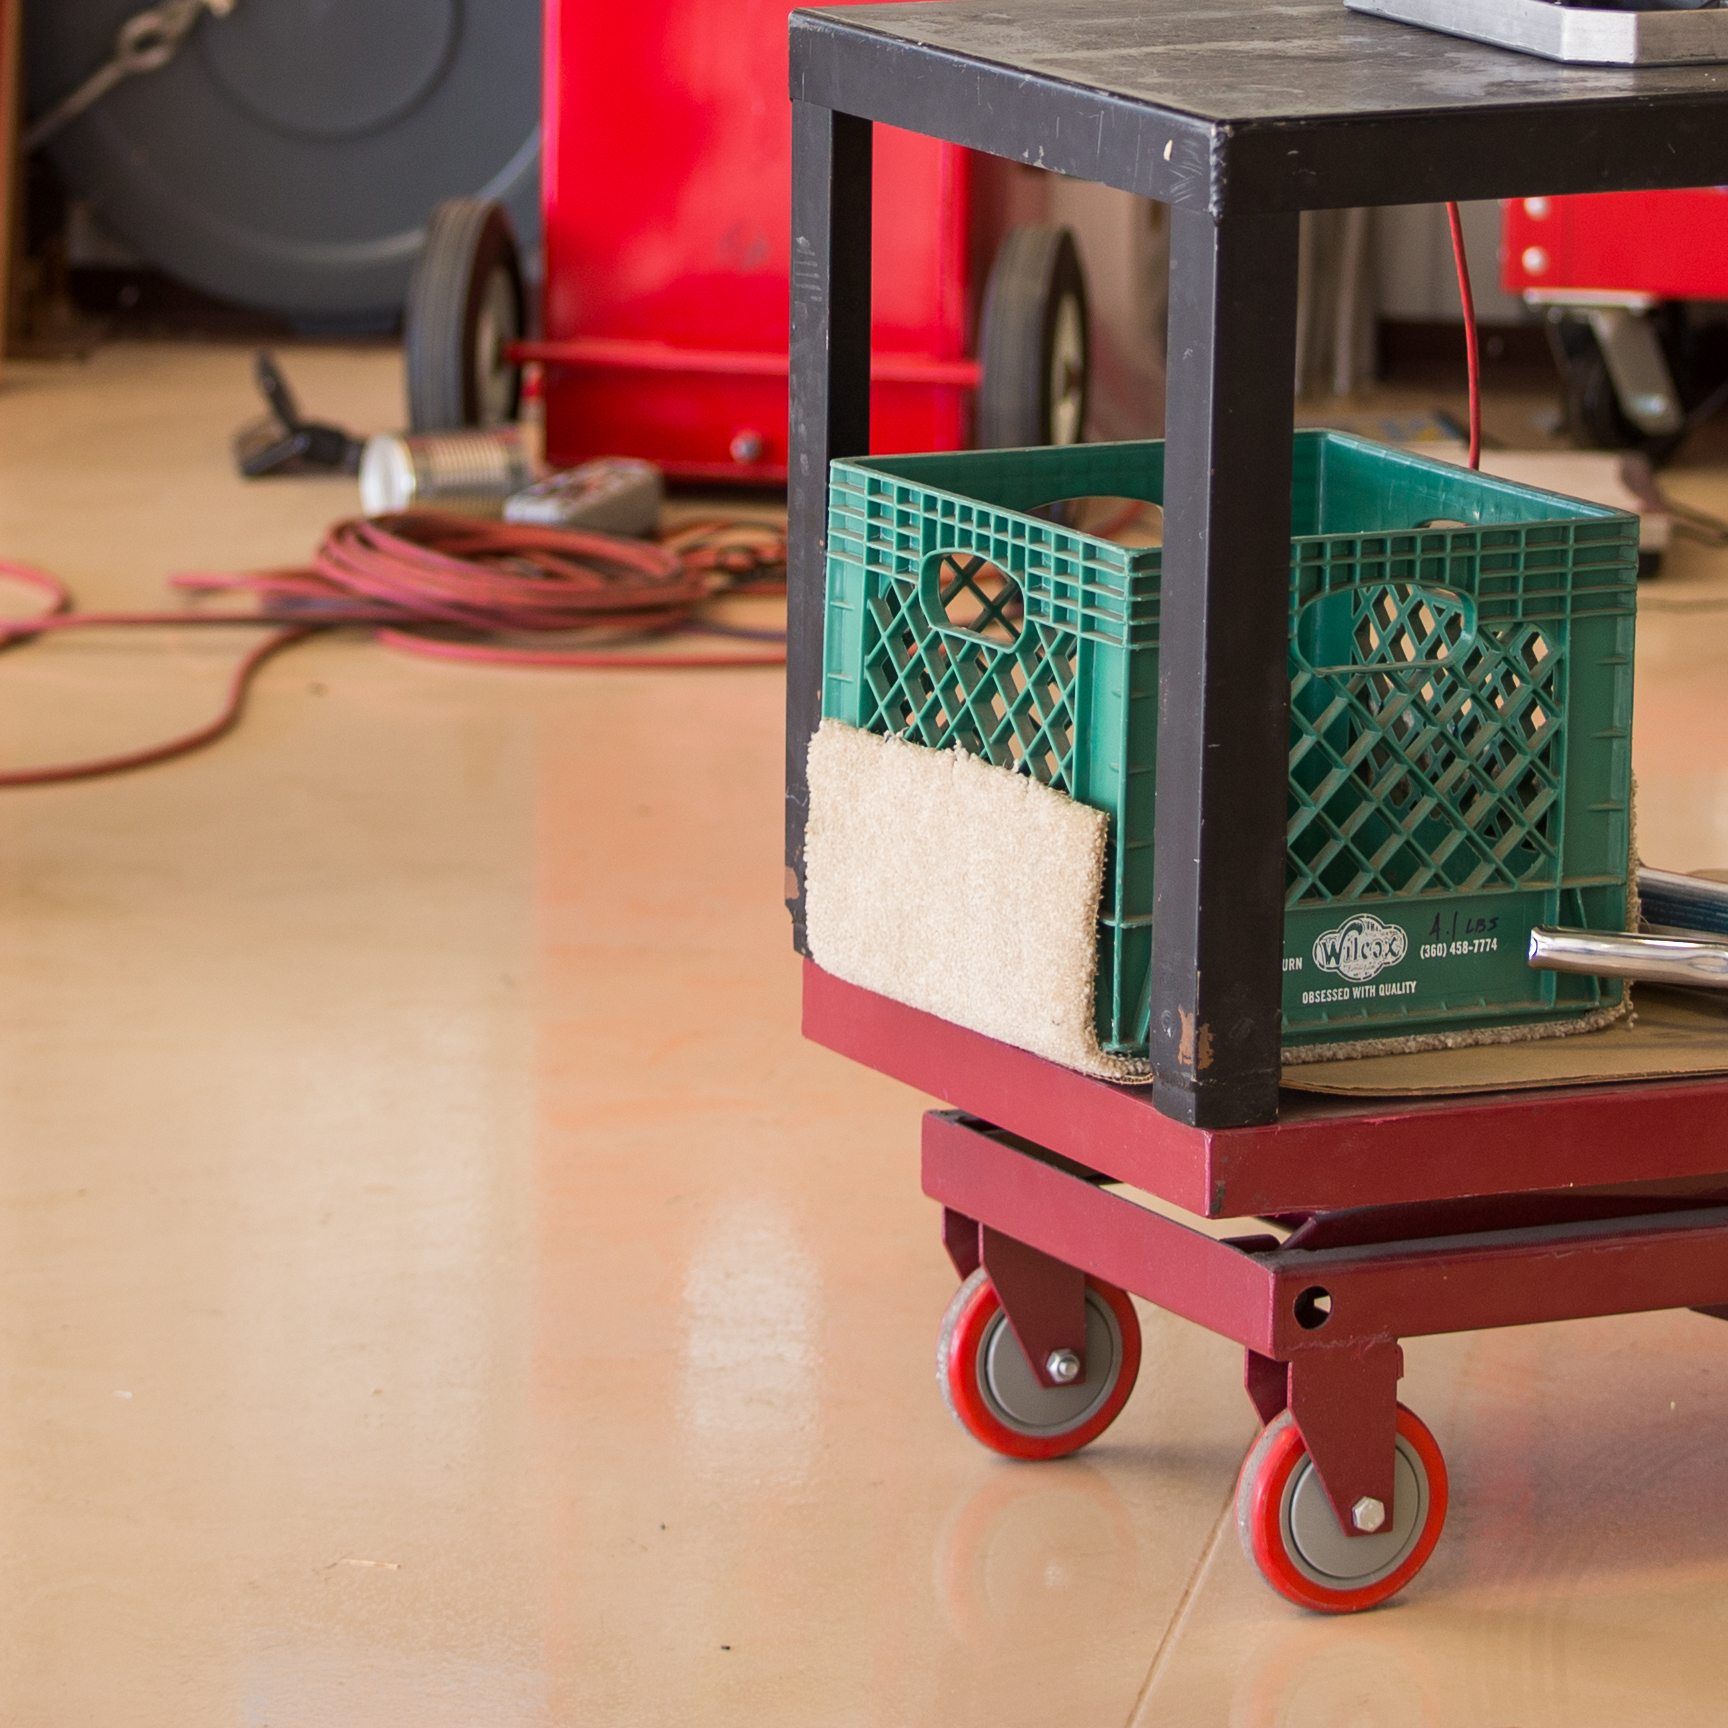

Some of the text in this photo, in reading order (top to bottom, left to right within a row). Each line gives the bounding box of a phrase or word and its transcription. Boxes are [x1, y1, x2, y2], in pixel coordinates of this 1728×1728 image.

[1466, 917, 1499, 934] LBS
[1320, 920, 1399, 968] Wilcox
[1420, 937, 1498, 960] (360) 458-7774
[1282, 956, 1303, 972] URN
[1302, 981, 1417, 1004] OBSESSED WITH QUALITY
